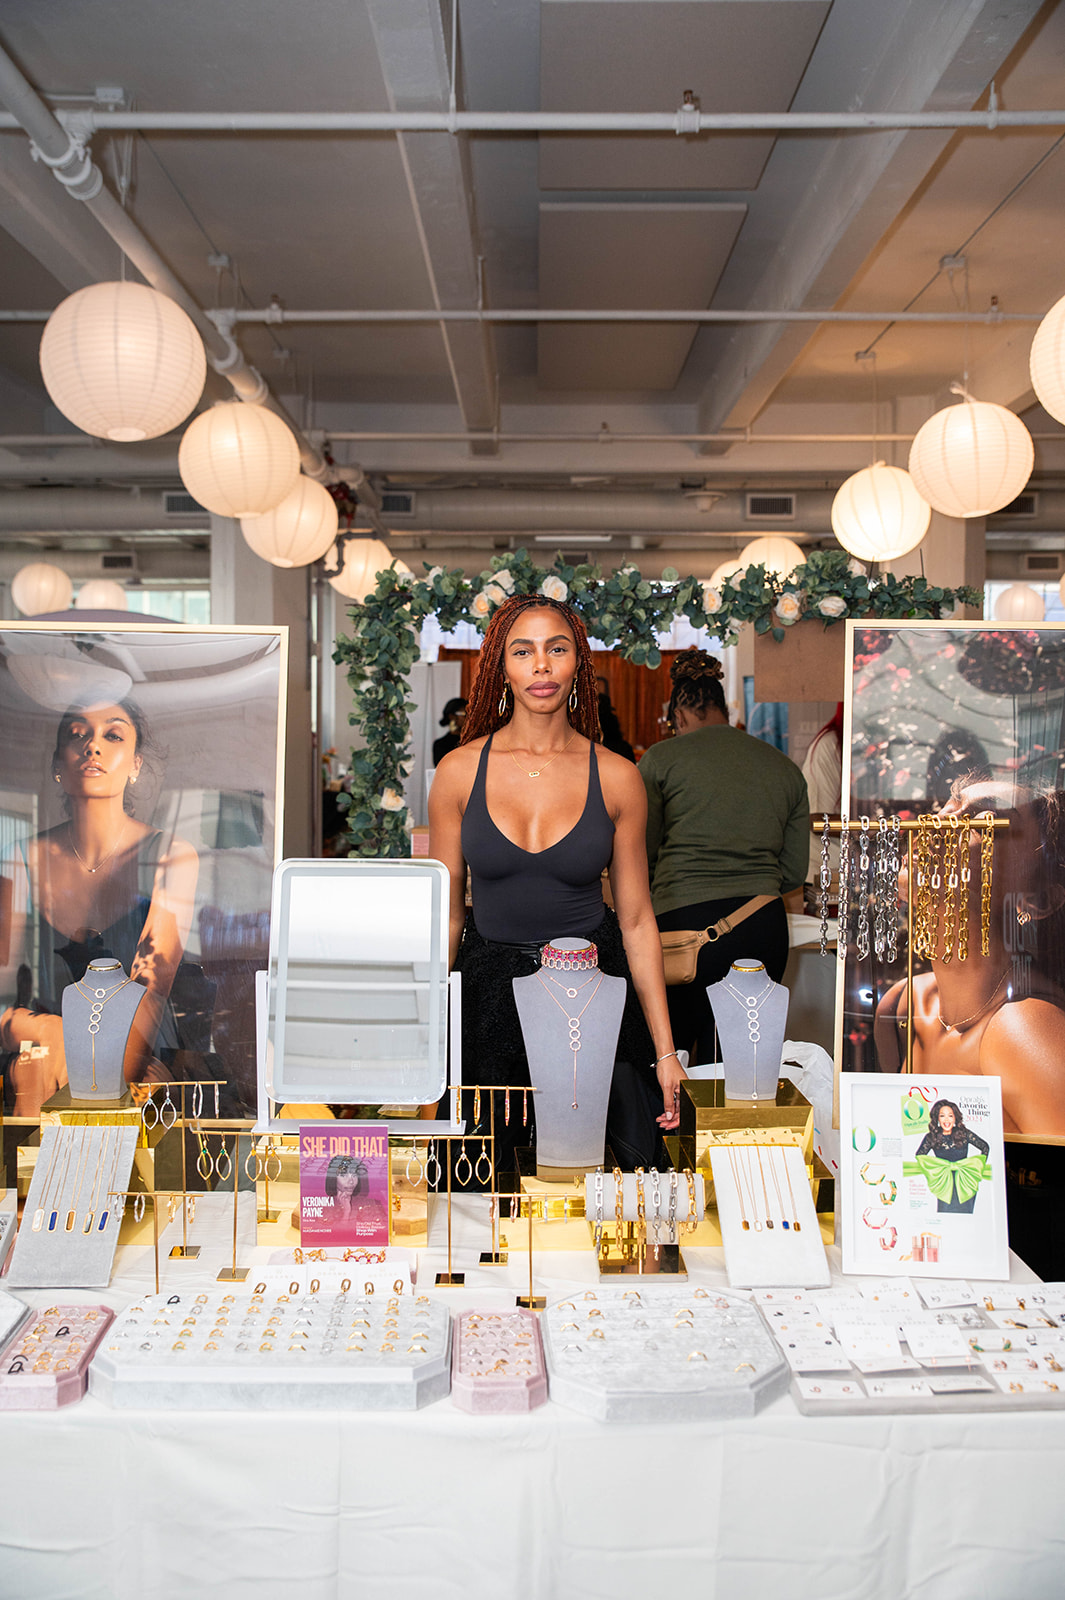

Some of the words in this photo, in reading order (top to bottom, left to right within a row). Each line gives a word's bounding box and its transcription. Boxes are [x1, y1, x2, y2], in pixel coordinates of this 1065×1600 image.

[903, 1099, 924, 1120] O
[968, 1109, 991, 1117] Thing
[302, 1136, 327, 1157] SHE
[329, 1136, 351, 1157] DID
[352, 1136, 387, 1157] THAT.
[852, 1126, 876, 1153] O
[302, 1197, 335, 1206] VERONIKA
[302, 1207, 324, 1217] PAYNE
